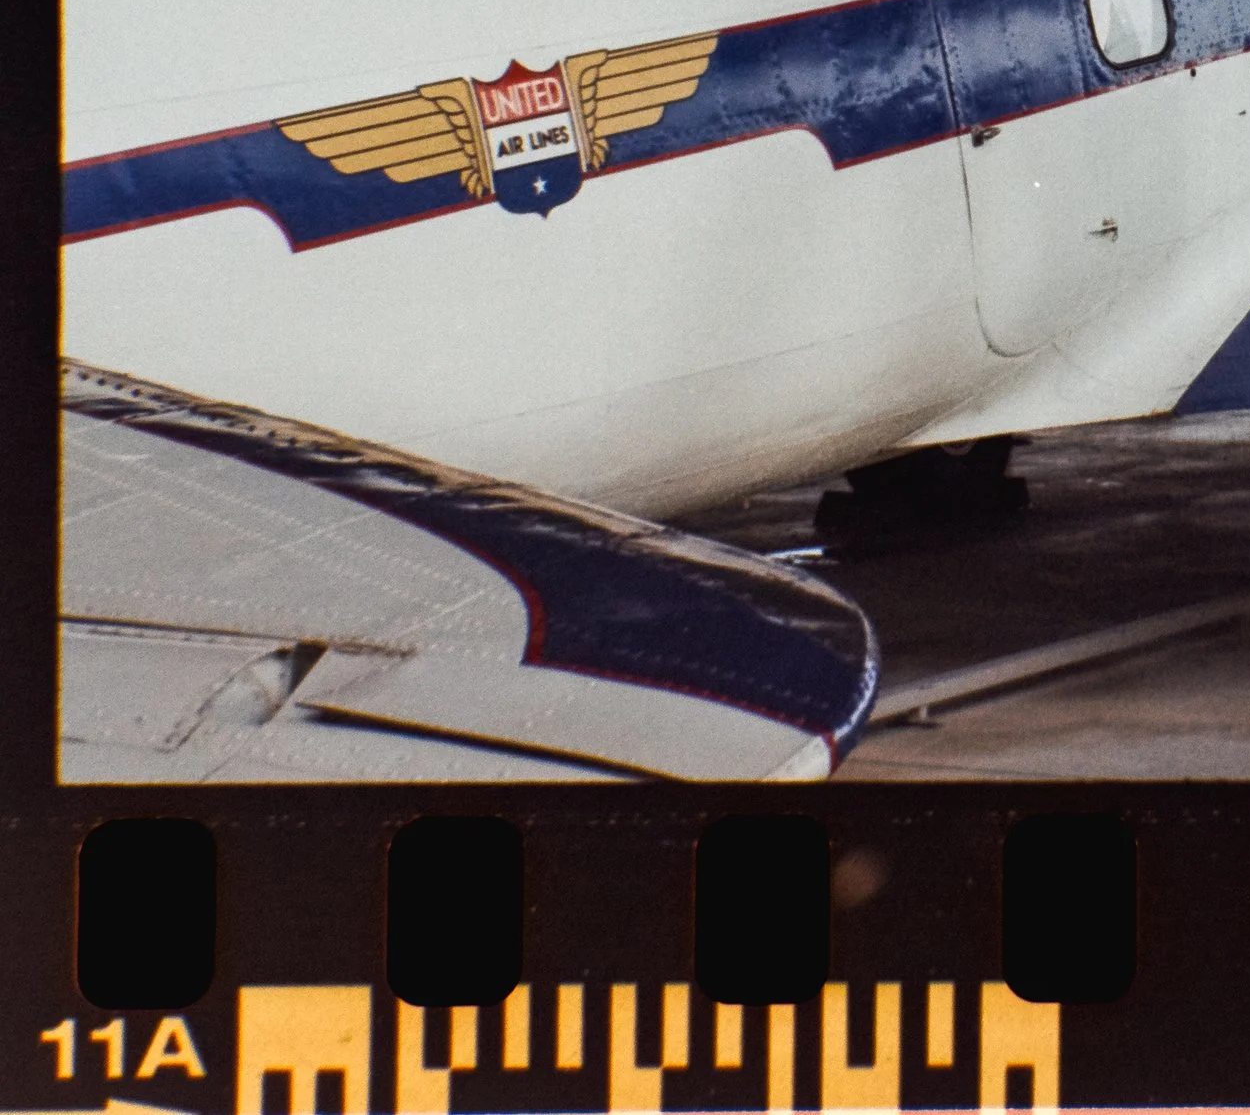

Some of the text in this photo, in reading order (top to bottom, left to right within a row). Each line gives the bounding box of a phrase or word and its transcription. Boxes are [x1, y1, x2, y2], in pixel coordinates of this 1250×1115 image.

[479, 77, 564, 123] UNITED
[497, 125, 570, 158] AIR LINES
[39, 1015, 207, 1081] 11A
